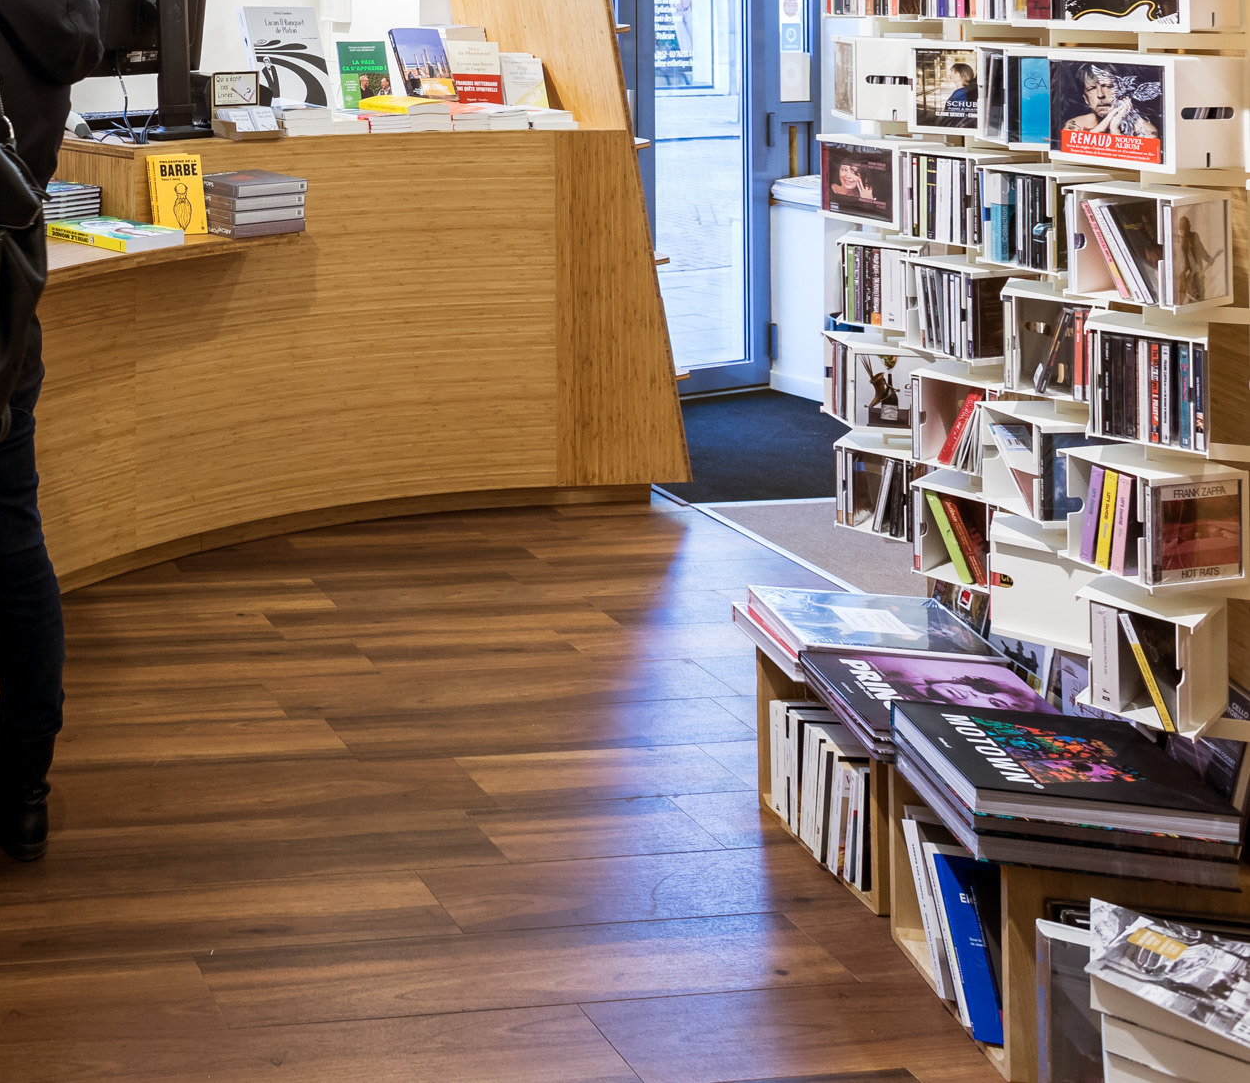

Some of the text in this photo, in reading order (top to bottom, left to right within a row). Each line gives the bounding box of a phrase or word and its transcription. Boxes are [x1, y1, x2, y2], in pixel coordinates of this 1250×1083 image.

[1070, 132, 1144, 147] RENAUD NOUVEL
[160, 163, 198, 177] BARBE
[1174, 486, 1226, 499] FRANK ZAPPA
[1181, 566, 1220, 578] HOT RATS
[1231, 702, 1249, 718] CELLO
